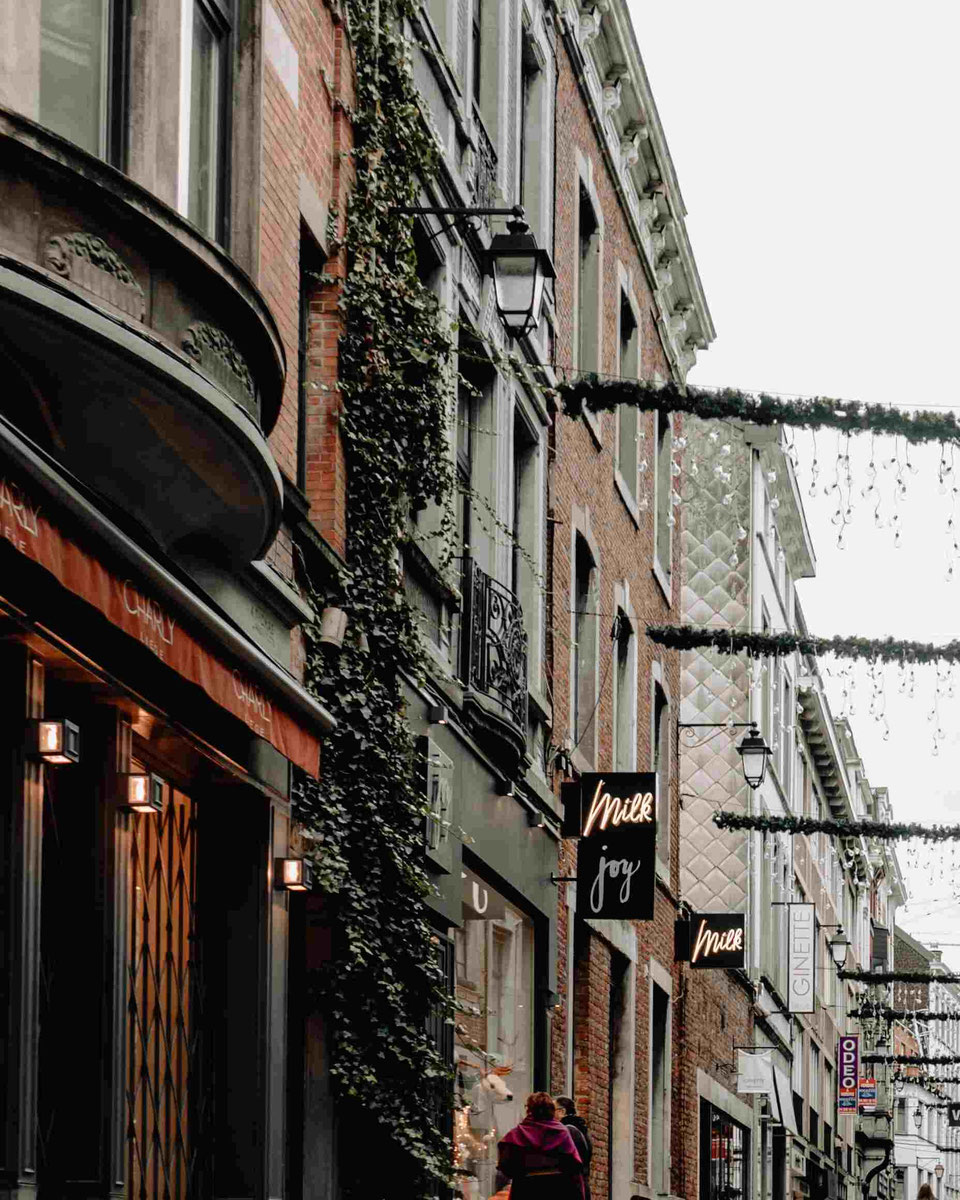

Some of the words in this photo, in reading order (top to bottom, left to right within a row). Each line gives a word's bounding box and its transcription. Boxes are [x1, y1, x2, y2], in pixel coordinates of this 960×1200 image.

[124, 580, 175, 647] CHARLY
[590, 844, 640, 913] joy
[793, 911, 810, 996] GINETTE
[842, 1039, 856, 1089] ODEO
